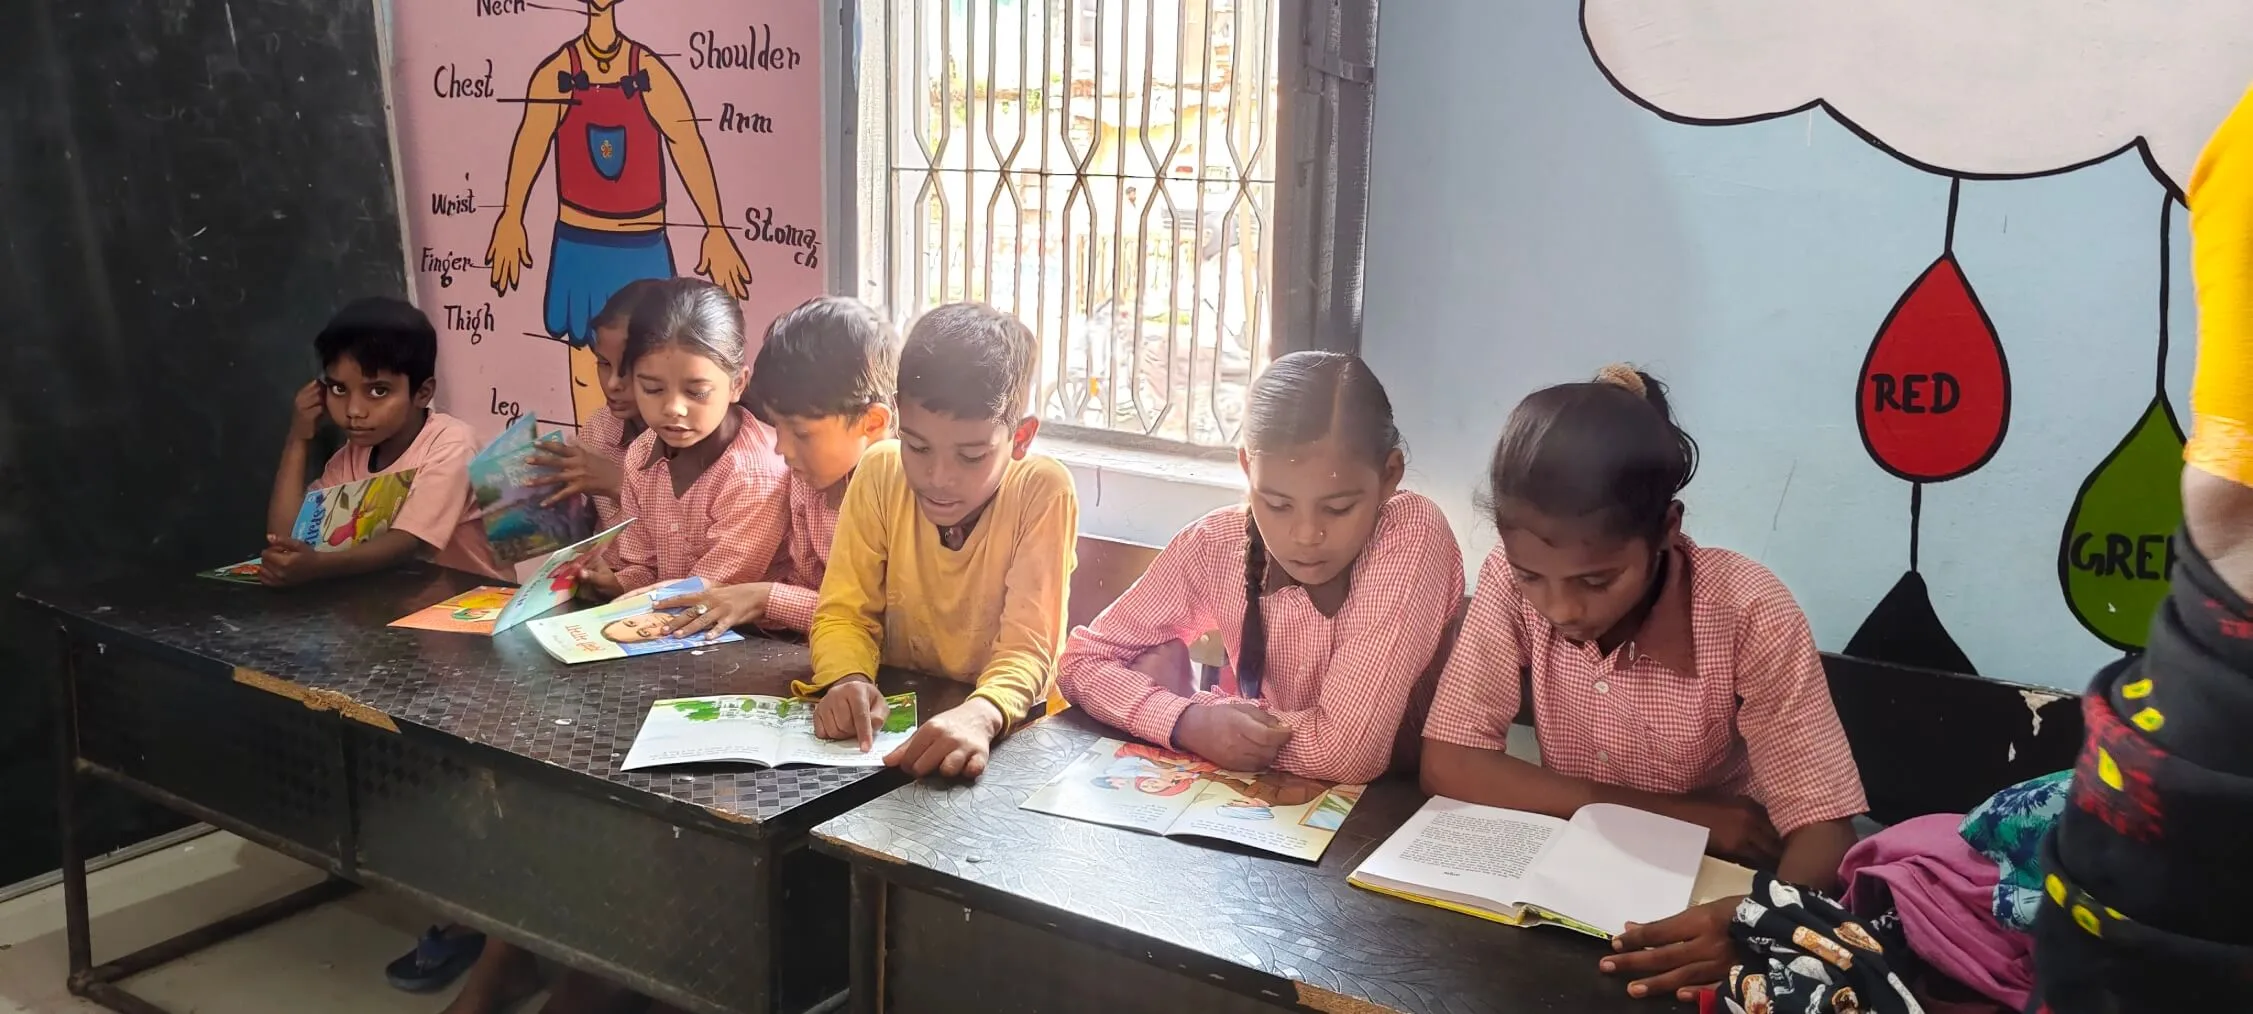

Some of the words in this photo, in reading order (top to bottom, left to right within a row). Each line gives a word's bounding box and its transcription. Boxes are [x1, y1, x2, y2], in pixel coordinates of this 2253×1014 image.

[689, 24, 800, 71] Shoulder
[434, 59, 494, 98] Chest
[719, 103, 773, 133] Arm
[432, 188, 476, 216] Wrist
[421, 247, 472, 288] Finger
[793, 245, 818, 269] ch
[444, 303, 494, 345] Thigh
[1871, 373, 1960, 413] RED
